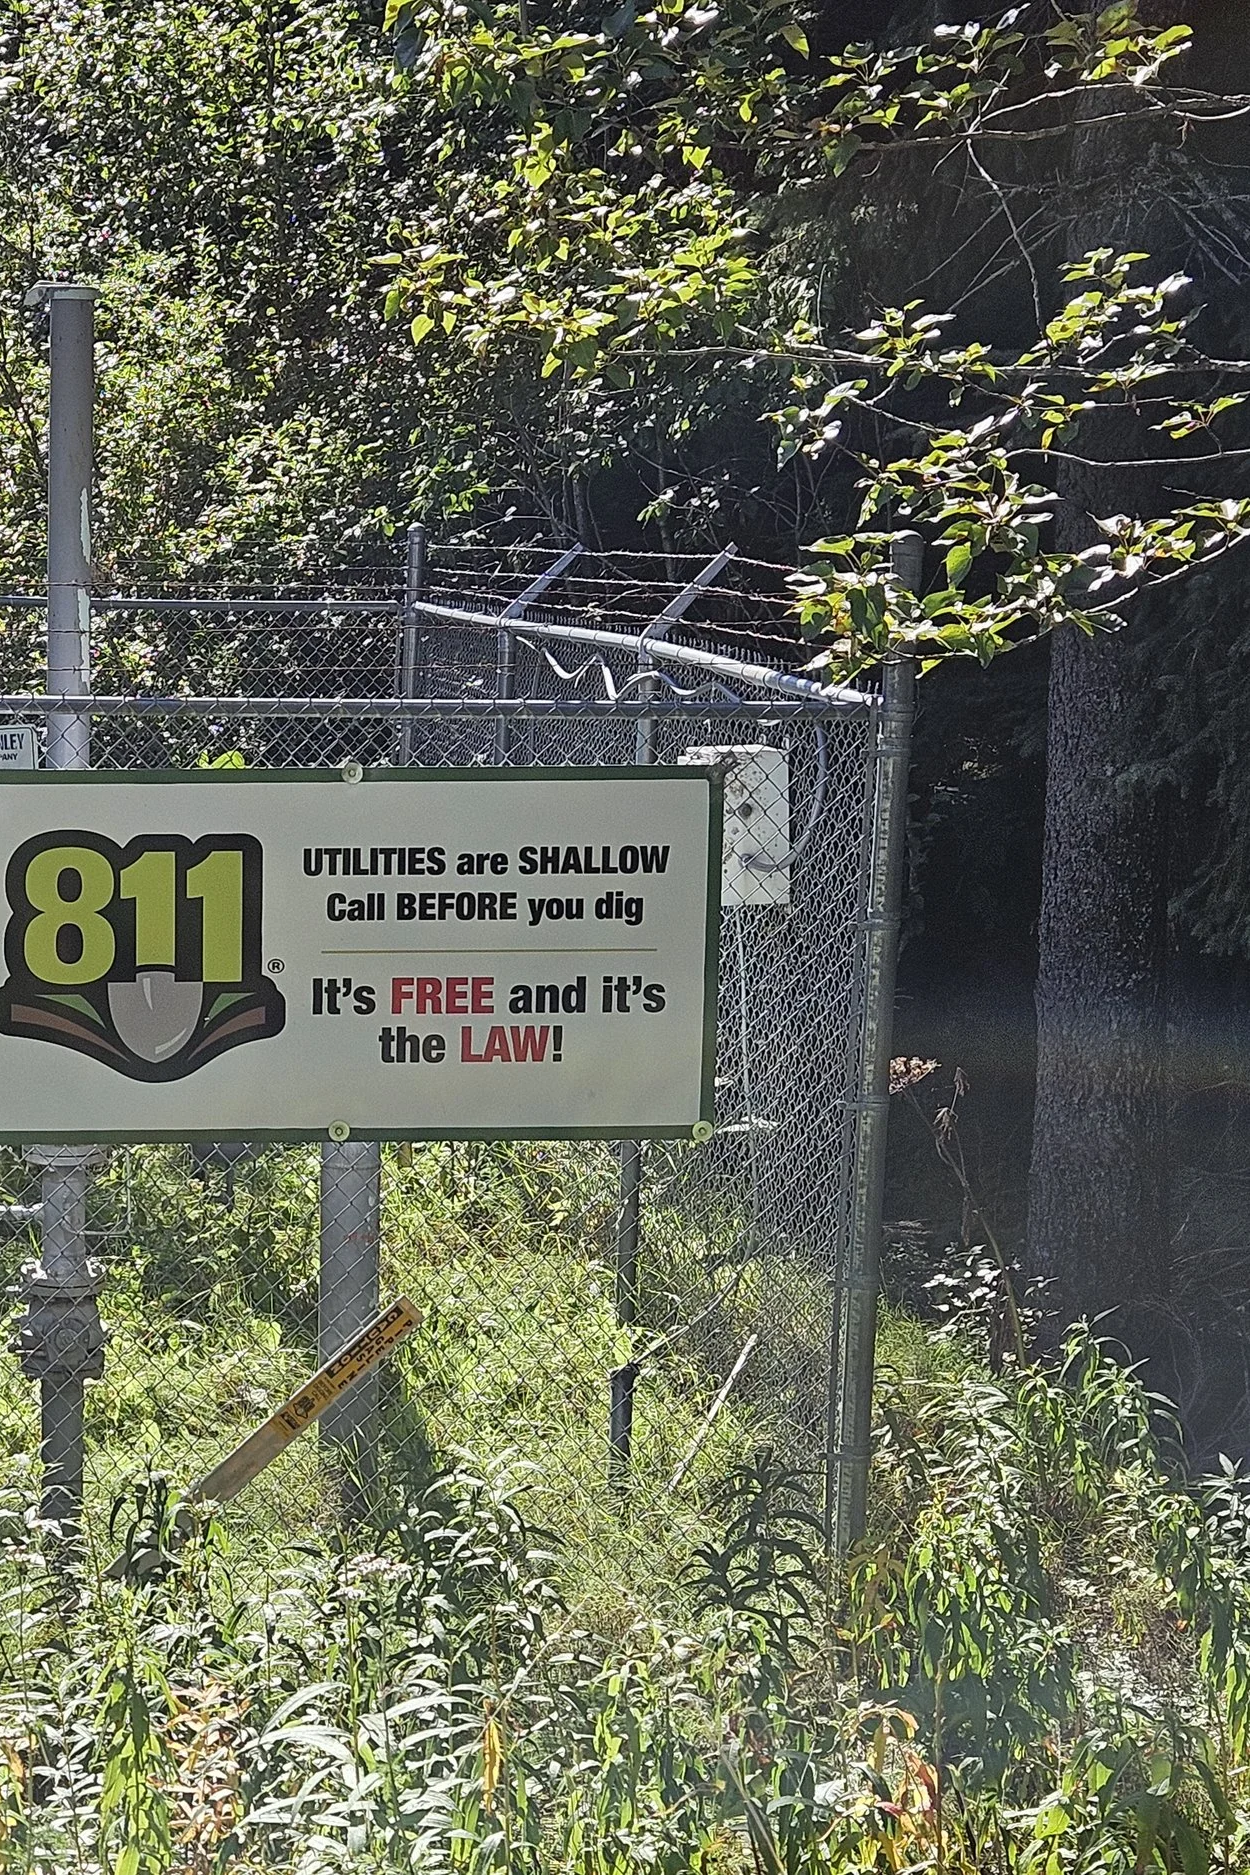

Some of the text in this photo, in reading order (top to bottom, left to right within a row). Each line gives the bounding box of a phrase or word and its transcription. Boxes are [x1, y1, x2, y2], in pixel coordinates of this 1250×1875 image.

[303, 845, 671, 877] UTILITIES are SHALLOW
[24, 846, 243, 985] 811
[326, 891, 644, 926] Call BEFORE you dig
[312, 976, 666, 1015] It's FREE and it's
[379, 1025, 563, 1063] the LAW!
[330, 1311, 398, 1375] CAUTION
[338, 1319, 413, 1390] PIPELINE
[356, 1335, 384, 1362] GAS
